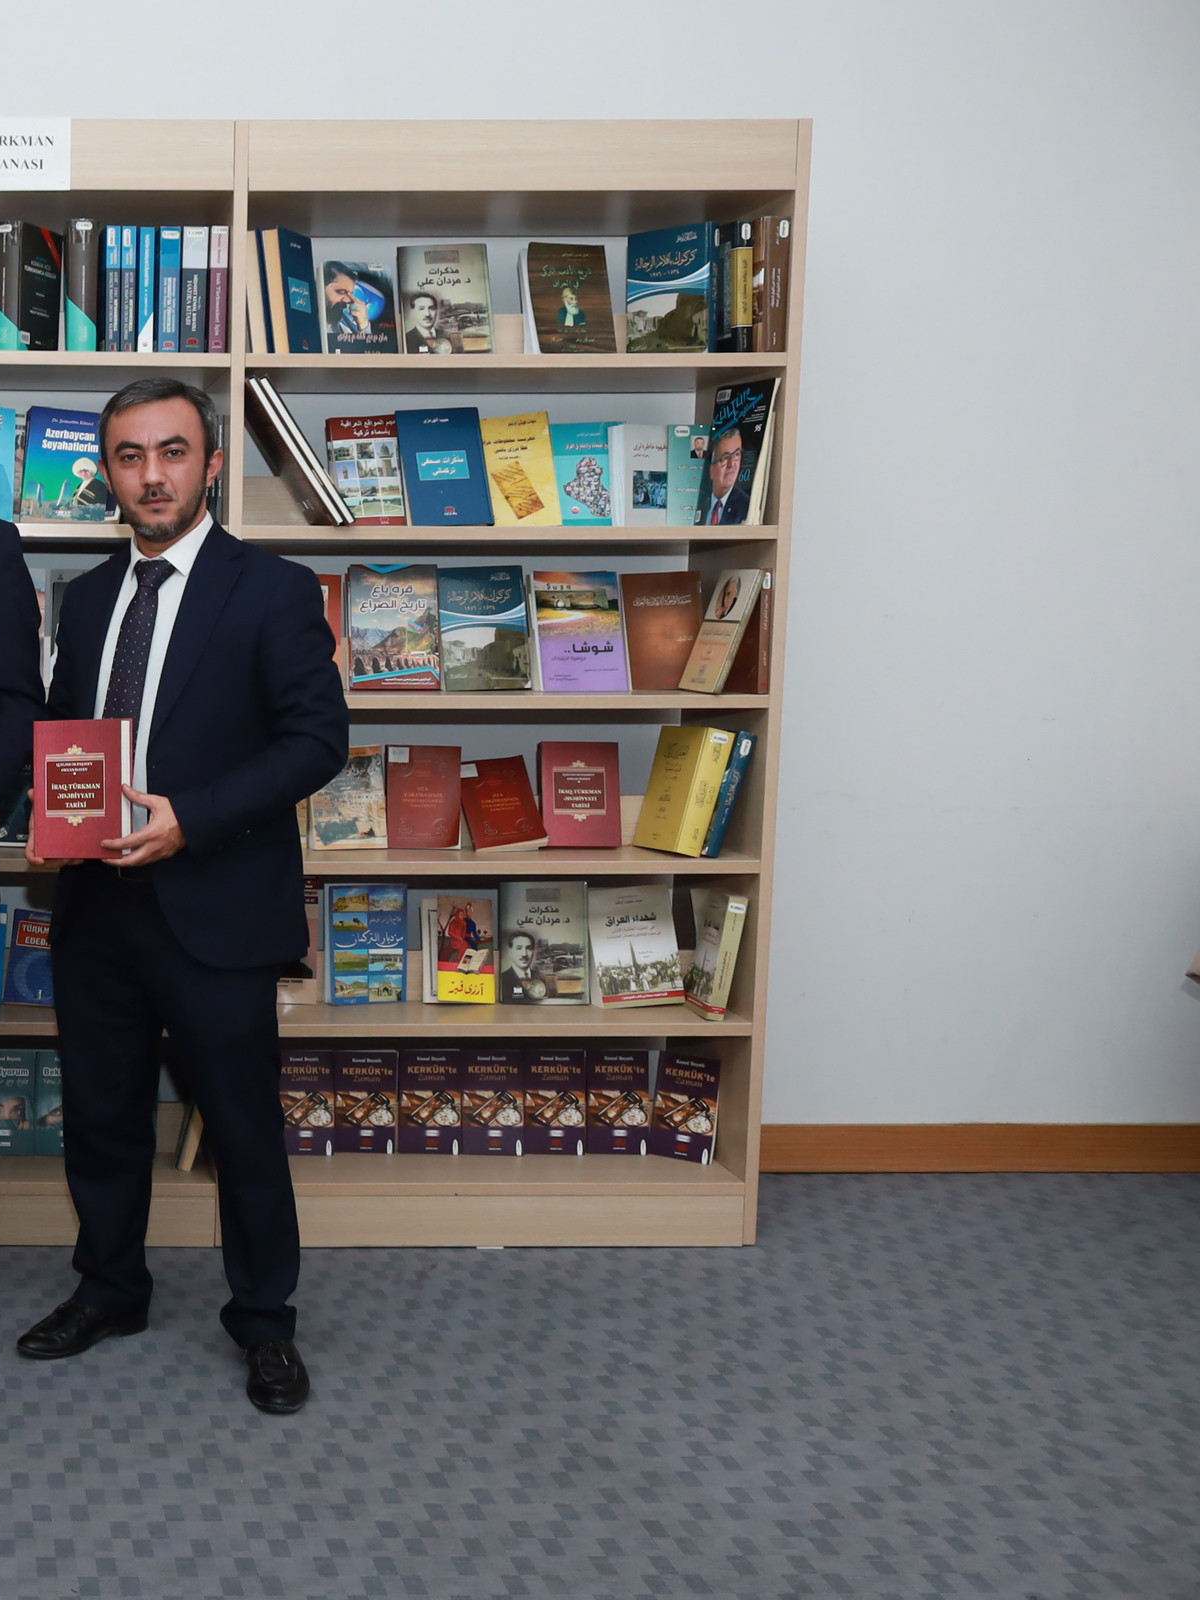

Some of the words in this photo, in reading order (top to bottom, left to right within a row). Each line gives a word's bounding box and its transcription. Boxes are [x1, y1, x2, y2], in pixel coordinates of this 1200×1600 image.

[429, 267, 459, 276] مذكرات
[417, 277, 434, 290] علي
[436, 277, 461, 287] مردان
[45, 427, 96, 442] Azerbaycan
[371, 584, 390, 598] باغ
[392, 584, 413, 597] قره
[360, 599, 398, 613] الصراع
[400, 600, 426, 613] تاريخ
[51, 782, 101, 791] İRAQ-TÜRKMAN
[57, 791, 95, 799] ƏDƏBİYYATI
[529, 906, 559, 915] مذكرات
[516, 916, 534, 928] علي
[536, 916, 560, 926] مردان
[605, 915, 630, 927] العراق
[633, 912, 657, 923] شهداء
[281, 1065, 331, 1074] KERKÜK'te
[342, 1067, 393, 1076] KERKÜK'te
[408, 1065, 457, 1074] KERKÜK'te
[468, 1064, 519, 1074] KERKÜK'te
[531, 1064, 582, 1074] KERKÜK'te
[595, 1064, 645, 1074] KERKÜK'te
[665, 1067, 716, 1082] KERKÜK'te
